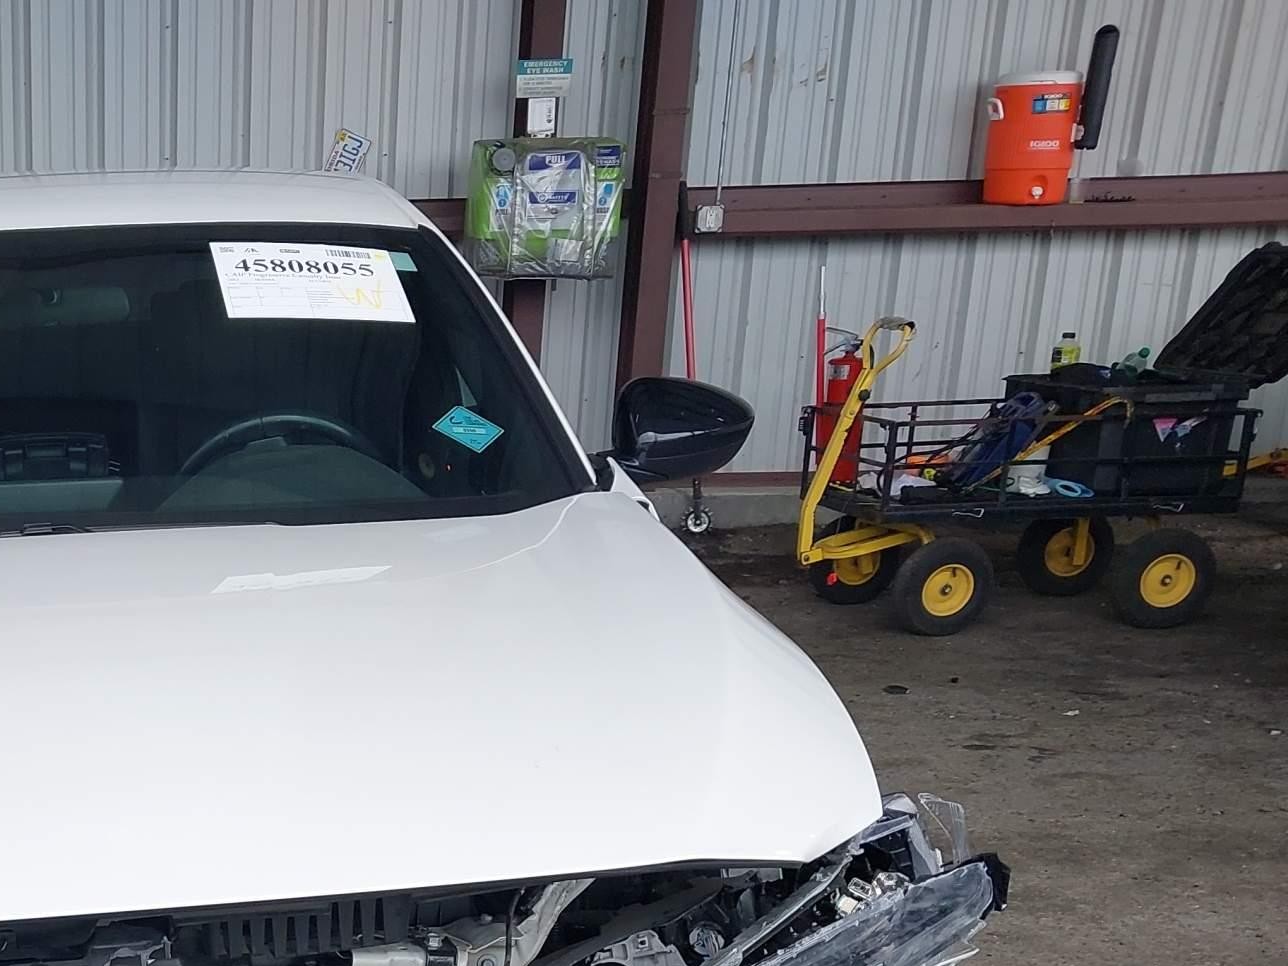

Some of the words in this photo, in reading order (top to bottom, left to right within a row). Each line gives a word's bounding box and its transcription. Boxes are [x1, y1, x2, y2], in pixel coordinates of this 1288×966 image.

[524, 60, 569, 68] EMERGENCY
[545, 155, 566, 164] PULL
[234, 258, 374, 277] 45808055
